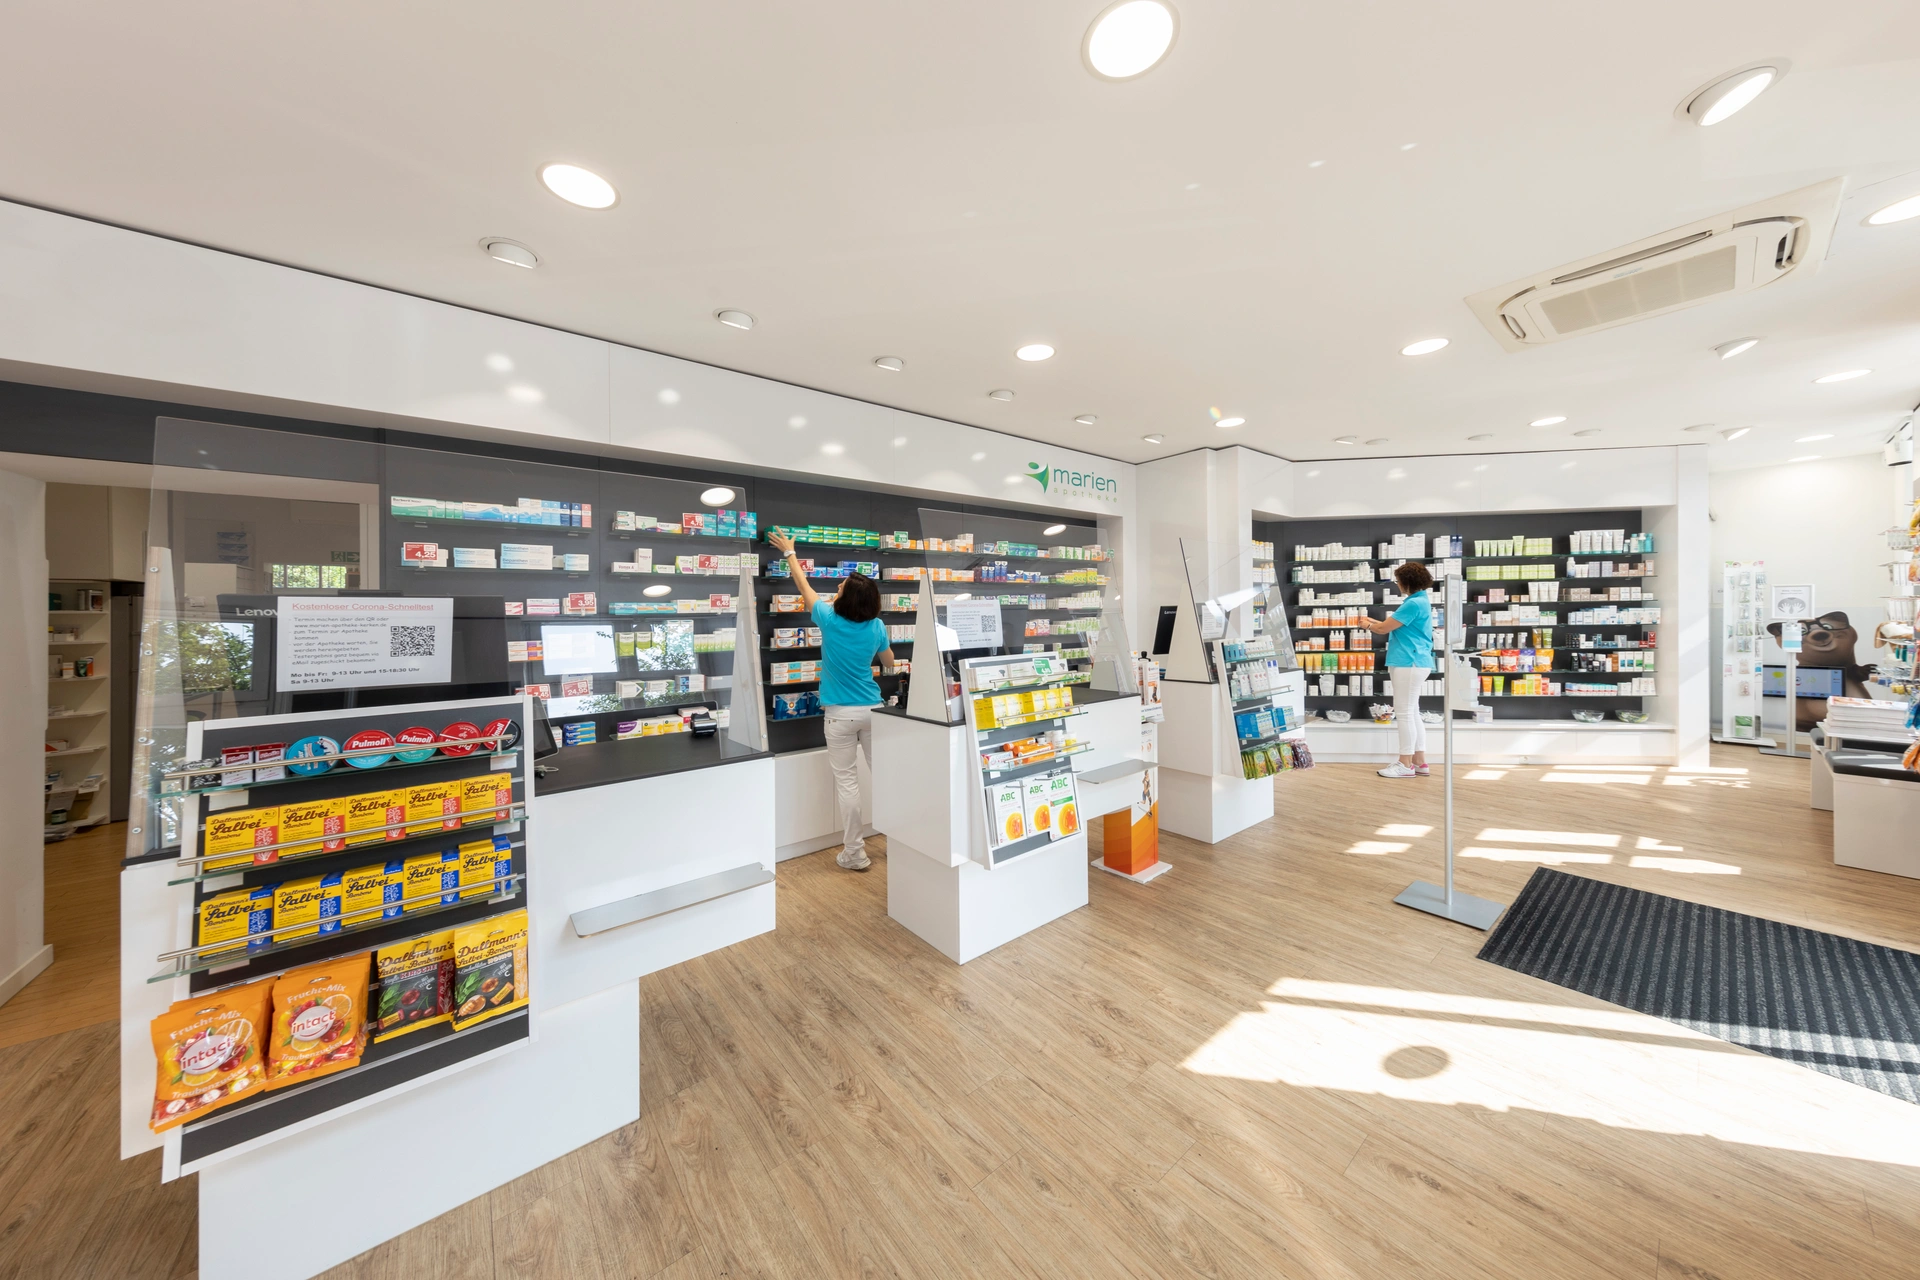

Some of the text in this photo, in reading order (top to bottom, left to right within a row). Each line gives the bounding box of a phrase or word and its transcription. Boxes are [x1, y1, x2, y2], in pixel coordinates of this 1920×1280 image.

[1053, 468, 1117, 493] marien
[1053, 487, 1118, 503] apotheke
[235, 607, 278, 617] Lenov
[292, 603, 434, 611] Kostenloser Corona-Schnelltest
[567, 688, 588, 696] 24,95
[352, 737, 387, 749] Pulmoll
[400, 734, 434, 744] Pulmoll
[464, 779, 494, 787] Dallmann's
[1050, 777, 1068, 791] ABC
[409, 787, 442, 796] Dallmann's
[1029, 784, 1044, 795] ABC
[349, 794, 386, 804] Dallmann's
[1000, 791, 1016, 803] ABC
[283, 804, 323, 814] Dallmann's
[210, 814, 255, 825] Dallmann's
[463, 850, 494, 859] Dallmann's
[407, 861, 441, 871] Dallmann's
[346, 873, 383, 884] Dallmann's
[279, 886, 319, 898] Dallmann's
[205, 898, 249, 910] Dallmann's
[457, 928, 528, 959] Dallmann's
[378, 940, 455, 969] Dallmann's
[286, 983, 347, 1004] Frucht-Mix
[169, 1010, 242, 1040] Frucht-Mix
[292, 1010, 336, 1034] intact
[281, 1040, 344, 1061] Traubenzucker
[171, 1066, 247, 1099] Traubenzucker
